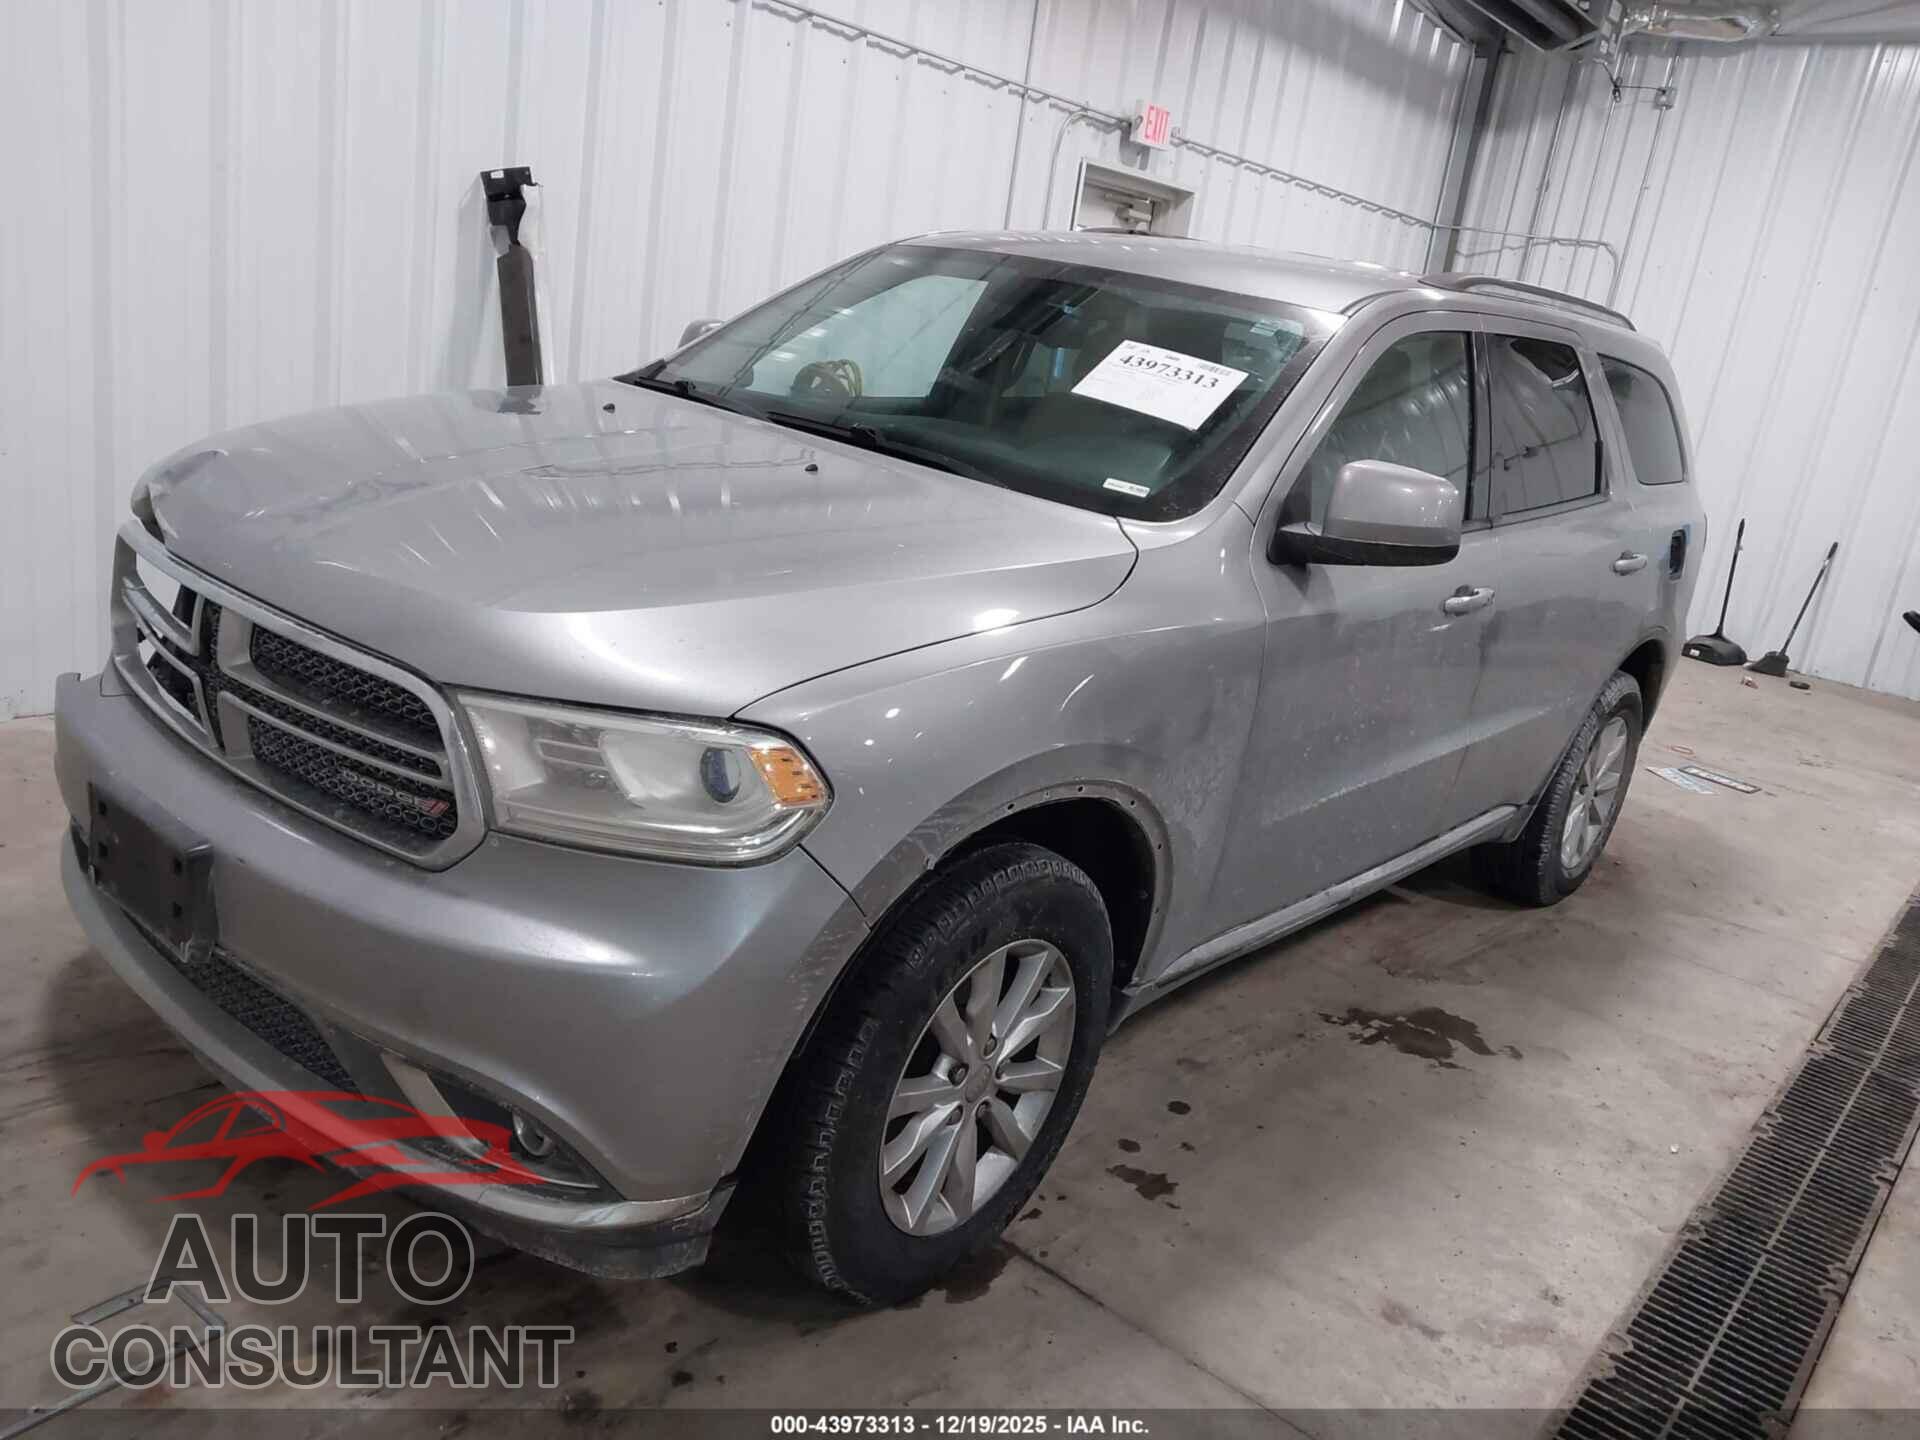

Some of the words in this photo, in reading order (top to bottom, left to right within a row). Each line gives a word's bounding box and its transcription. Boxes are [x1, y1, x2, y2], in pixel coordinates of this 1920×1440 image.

[1144, 104, 1169, 145] EXIT
[1119, 354, 1220, 389] 43973313
[342, 768, 427, 808] DODGE
